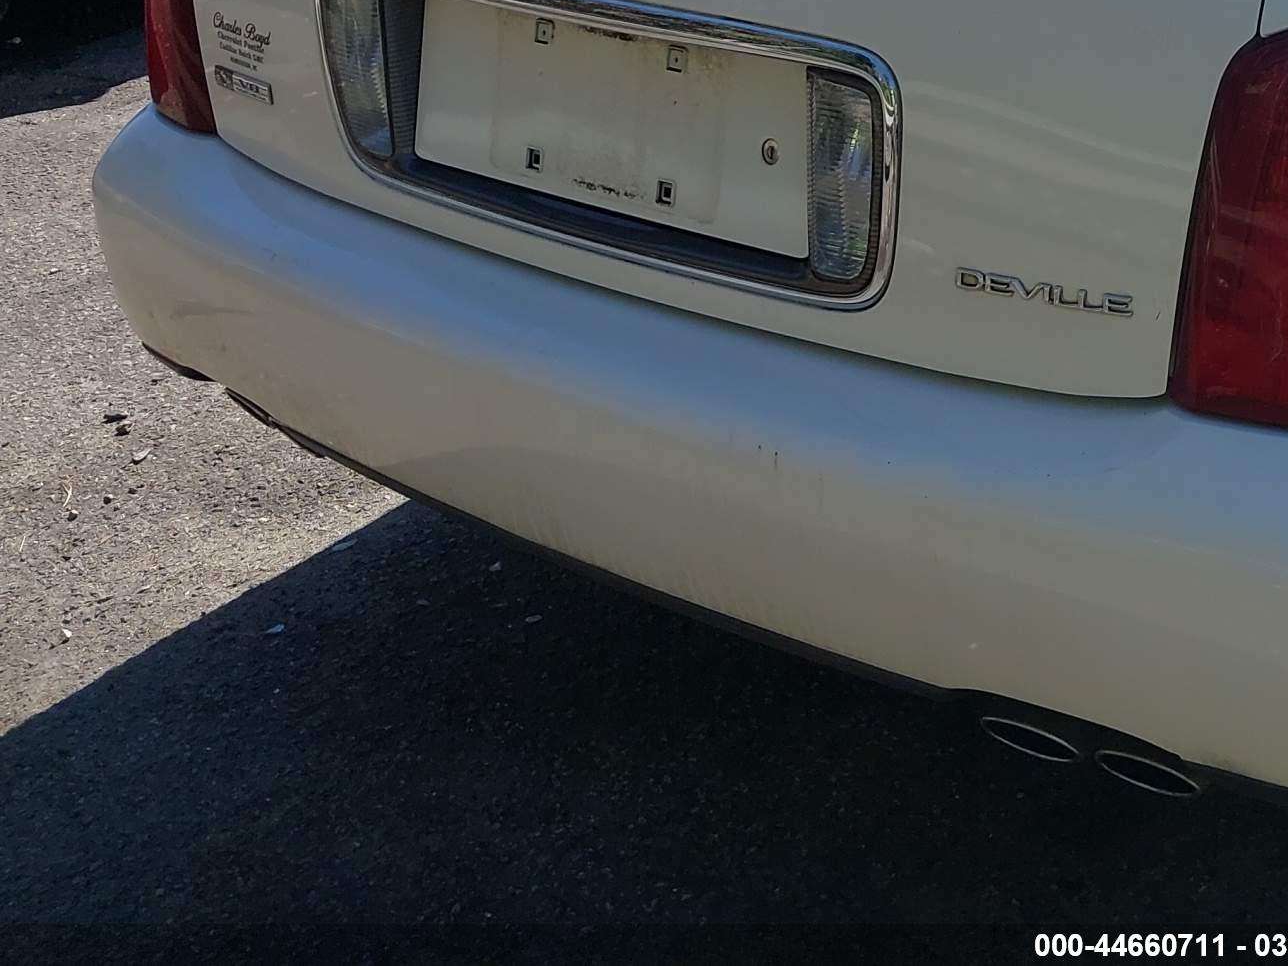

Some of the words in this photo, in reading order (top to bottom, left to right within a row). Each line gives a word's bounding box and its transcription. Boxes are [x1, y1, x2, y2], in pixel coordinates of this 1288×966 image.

[213, 12, 242, 36] Charles
[244, 23, 271, 48] Boyd
[955, 266, 1134, 317] DEVILLE
